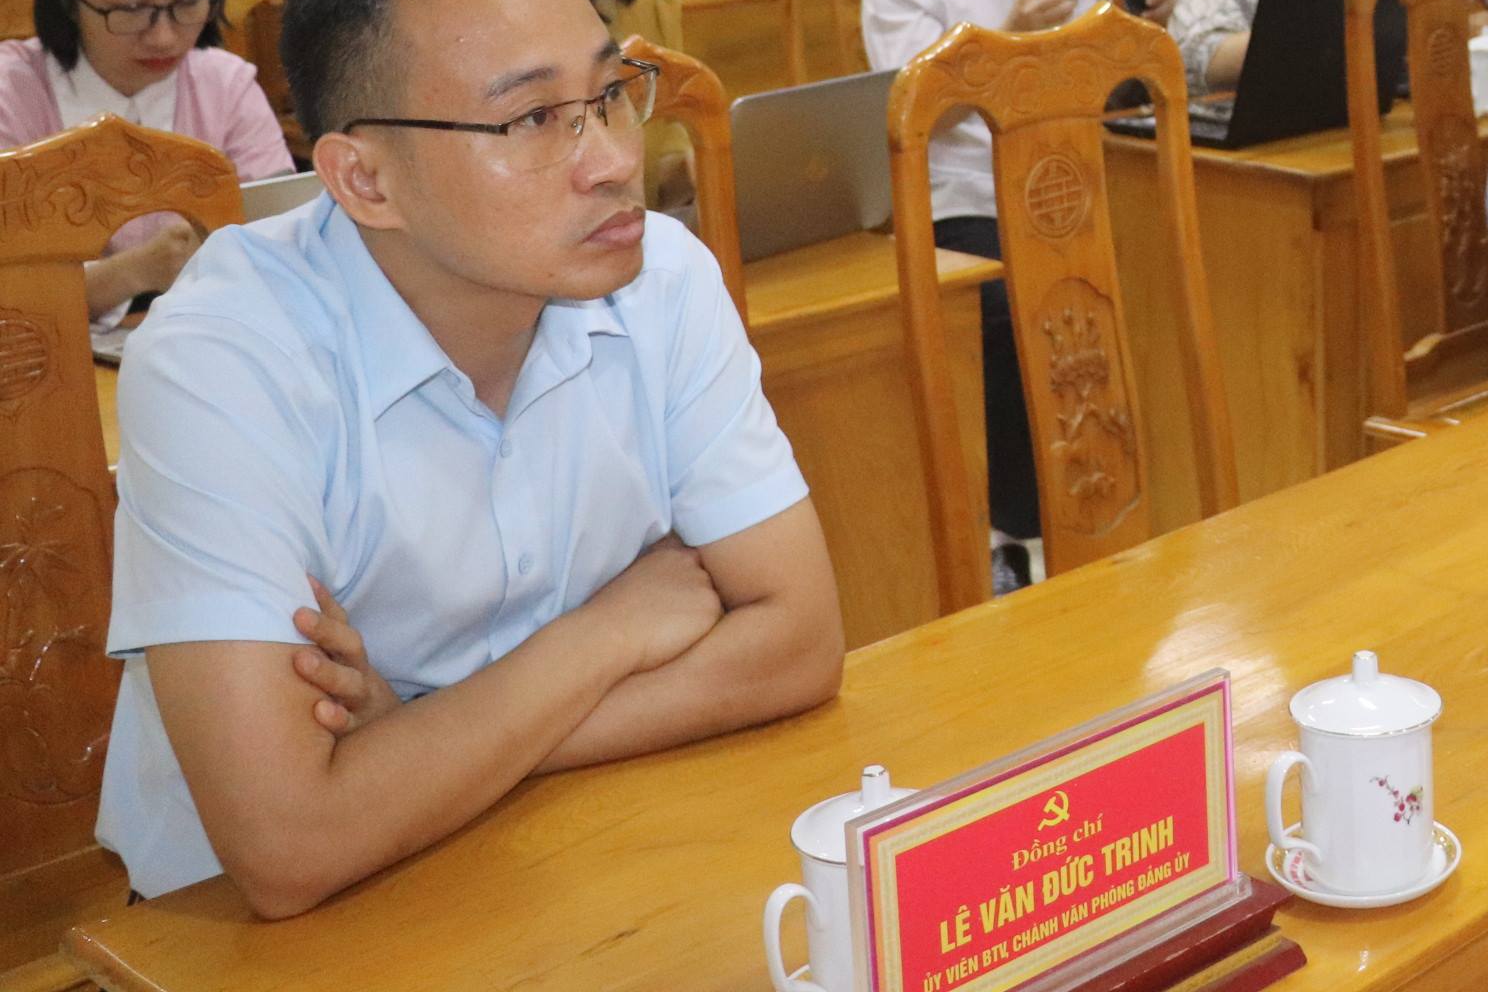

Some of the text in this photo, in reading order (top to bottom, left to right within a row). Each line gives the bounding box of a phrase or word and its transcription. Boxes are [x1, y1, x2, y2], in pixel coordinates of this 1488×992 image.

[940, 816, 1174, 954] LÊ VĂN ĐỨC TRINH
[1012, 813, 1103, 870] Đồng chí
[945, 955, 979, 984] VIÊN
[1012, 916, 1059, 952] CHÁNH
[1062, 901, 1089, 928] VĂN
[1091, 880, 1135, 914] PHÒNG
[1137, 861, 1172, 891] ĐẢNG
[1174, 852, 1190, 874] ỦY
